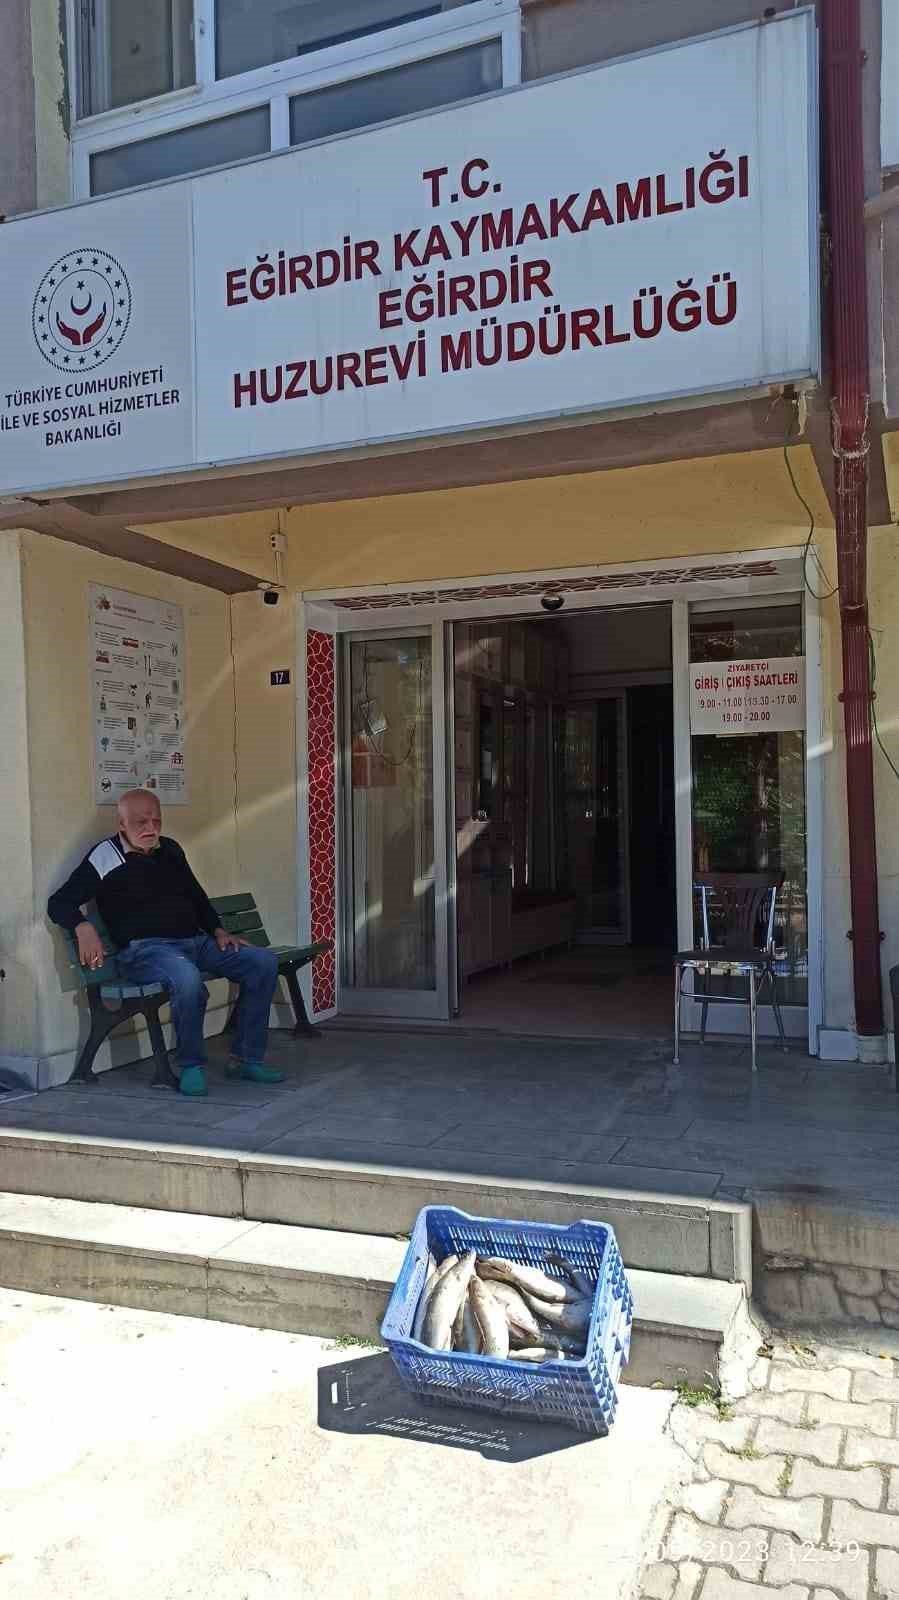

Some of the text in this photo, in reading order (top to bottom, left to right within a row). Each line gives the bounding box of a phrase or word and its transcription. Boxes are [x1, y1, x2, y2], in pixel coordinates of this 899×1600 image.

[422, 157, 502, 208] T.C.
[225, 148, 750, 307] EĞİRDİR KAYMAKAMLIĞI
[378, 254, 554, 329] EĞİRDİR
[233, 271, 738, 409] HUZUREVİ MÜDÜRLÜĞÜ
[5, 365, 163, 408] TÜRKİYE CUMHURİYETİ
[0, 389, 180, 432] İLE VE SOSYAL HİZMETLER
[45, 419, 121, 447] BAKANLIĞI
[275, 671, 284, 684] 17
[695, 675, 719, 691] GİRİŞ
[727, 675, 751, 691] ÇIKIŞ
[754, 671, 798, 687] SAATLERİ
[728, 662, 769, 673] ZİYARETÇİ
[750, 711, 770, 721] 20.00
